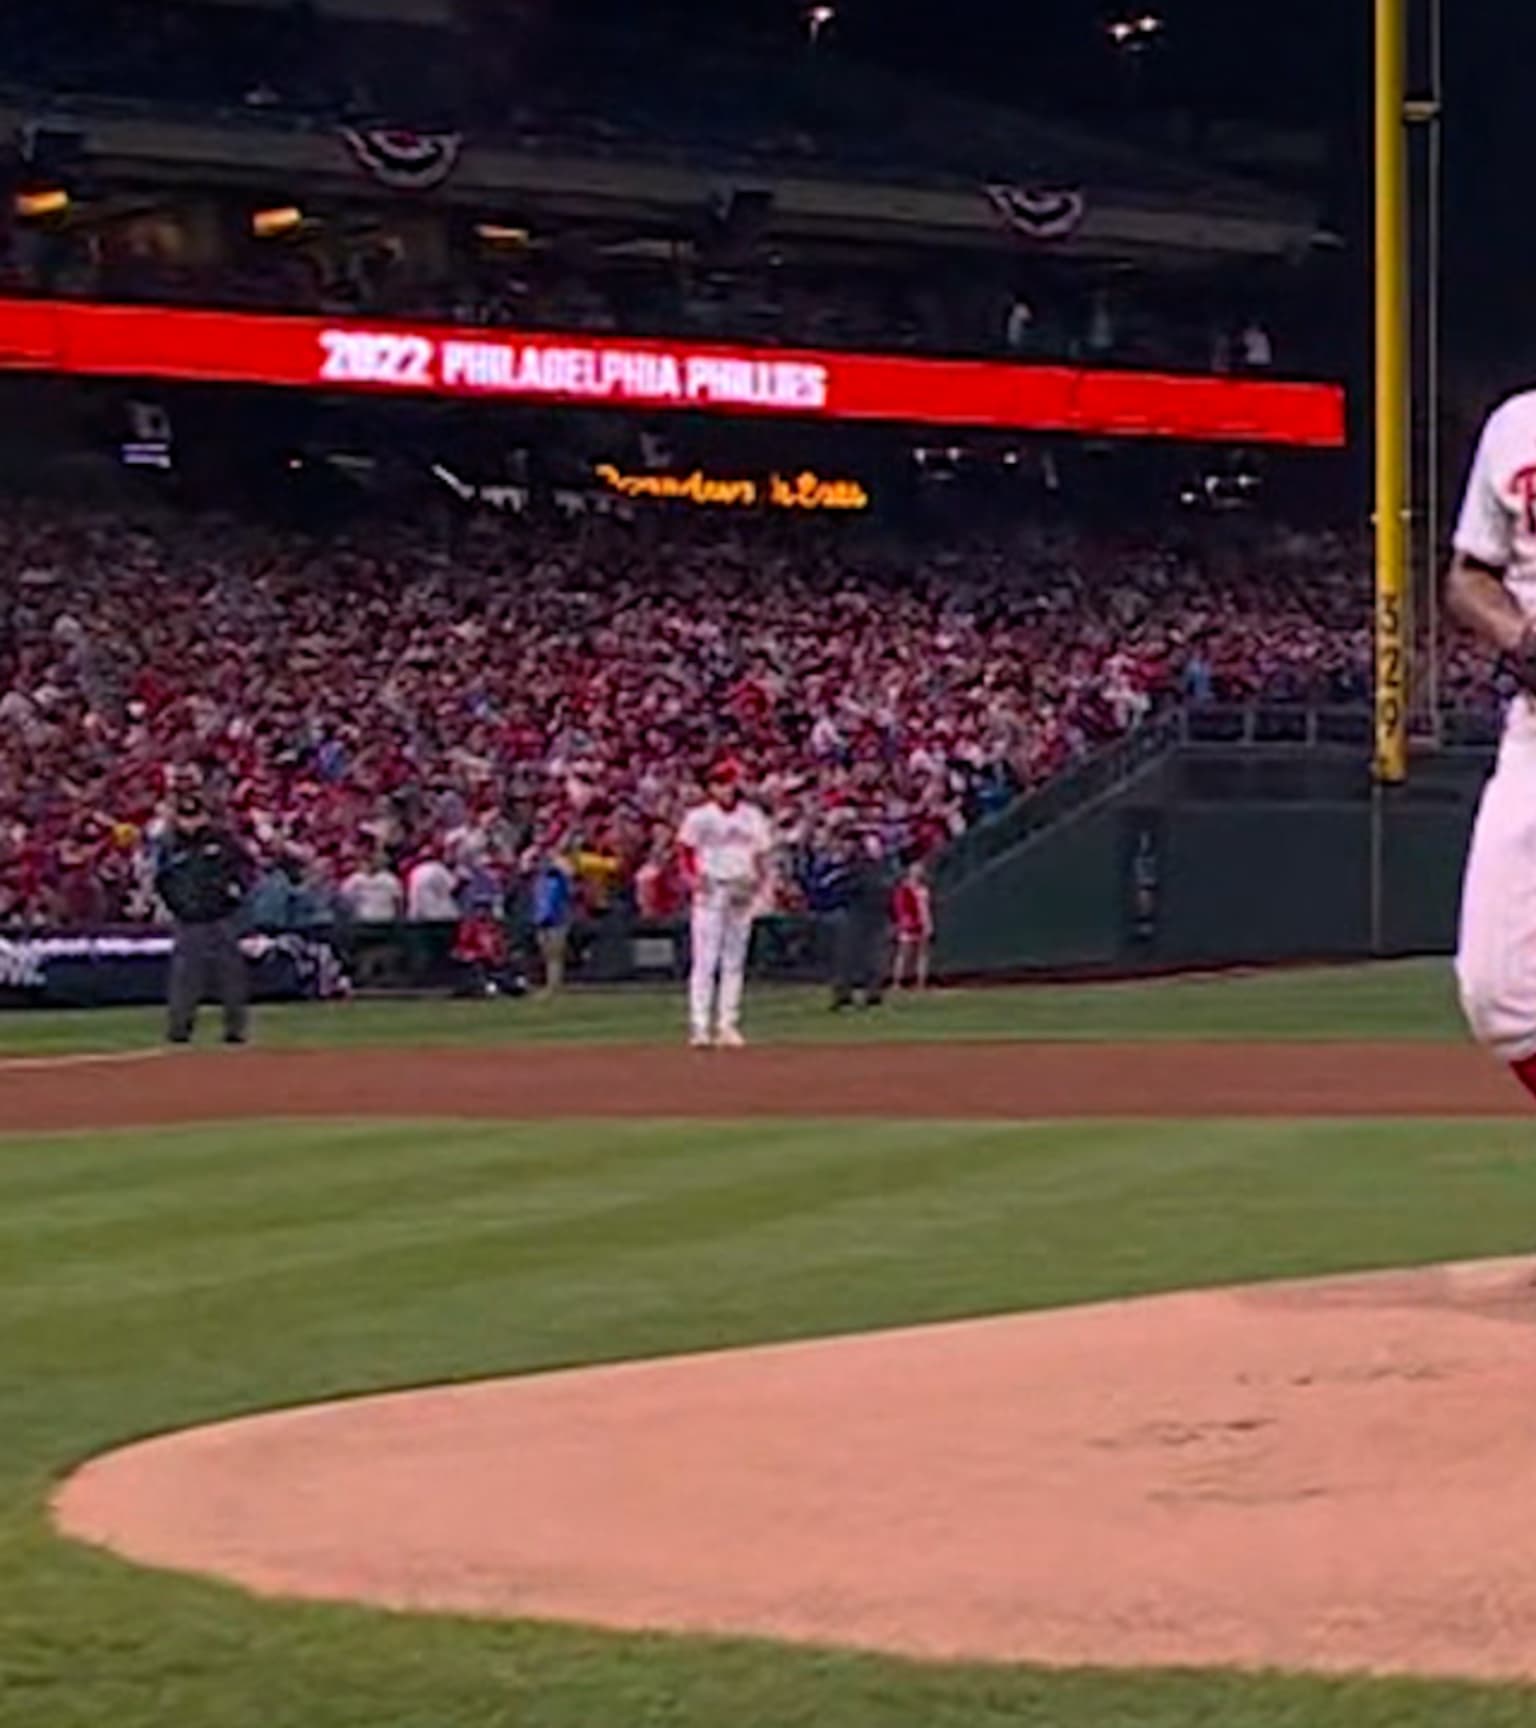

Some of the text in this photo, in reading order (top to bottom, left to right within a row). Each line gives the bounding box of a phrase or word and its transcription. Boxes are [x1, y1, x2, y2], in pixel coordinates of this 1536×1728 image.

[319, 329, 827, 408] 2022 PHILADELPHIA PHILLIES
[1380, 594, 1400, 738] 329
